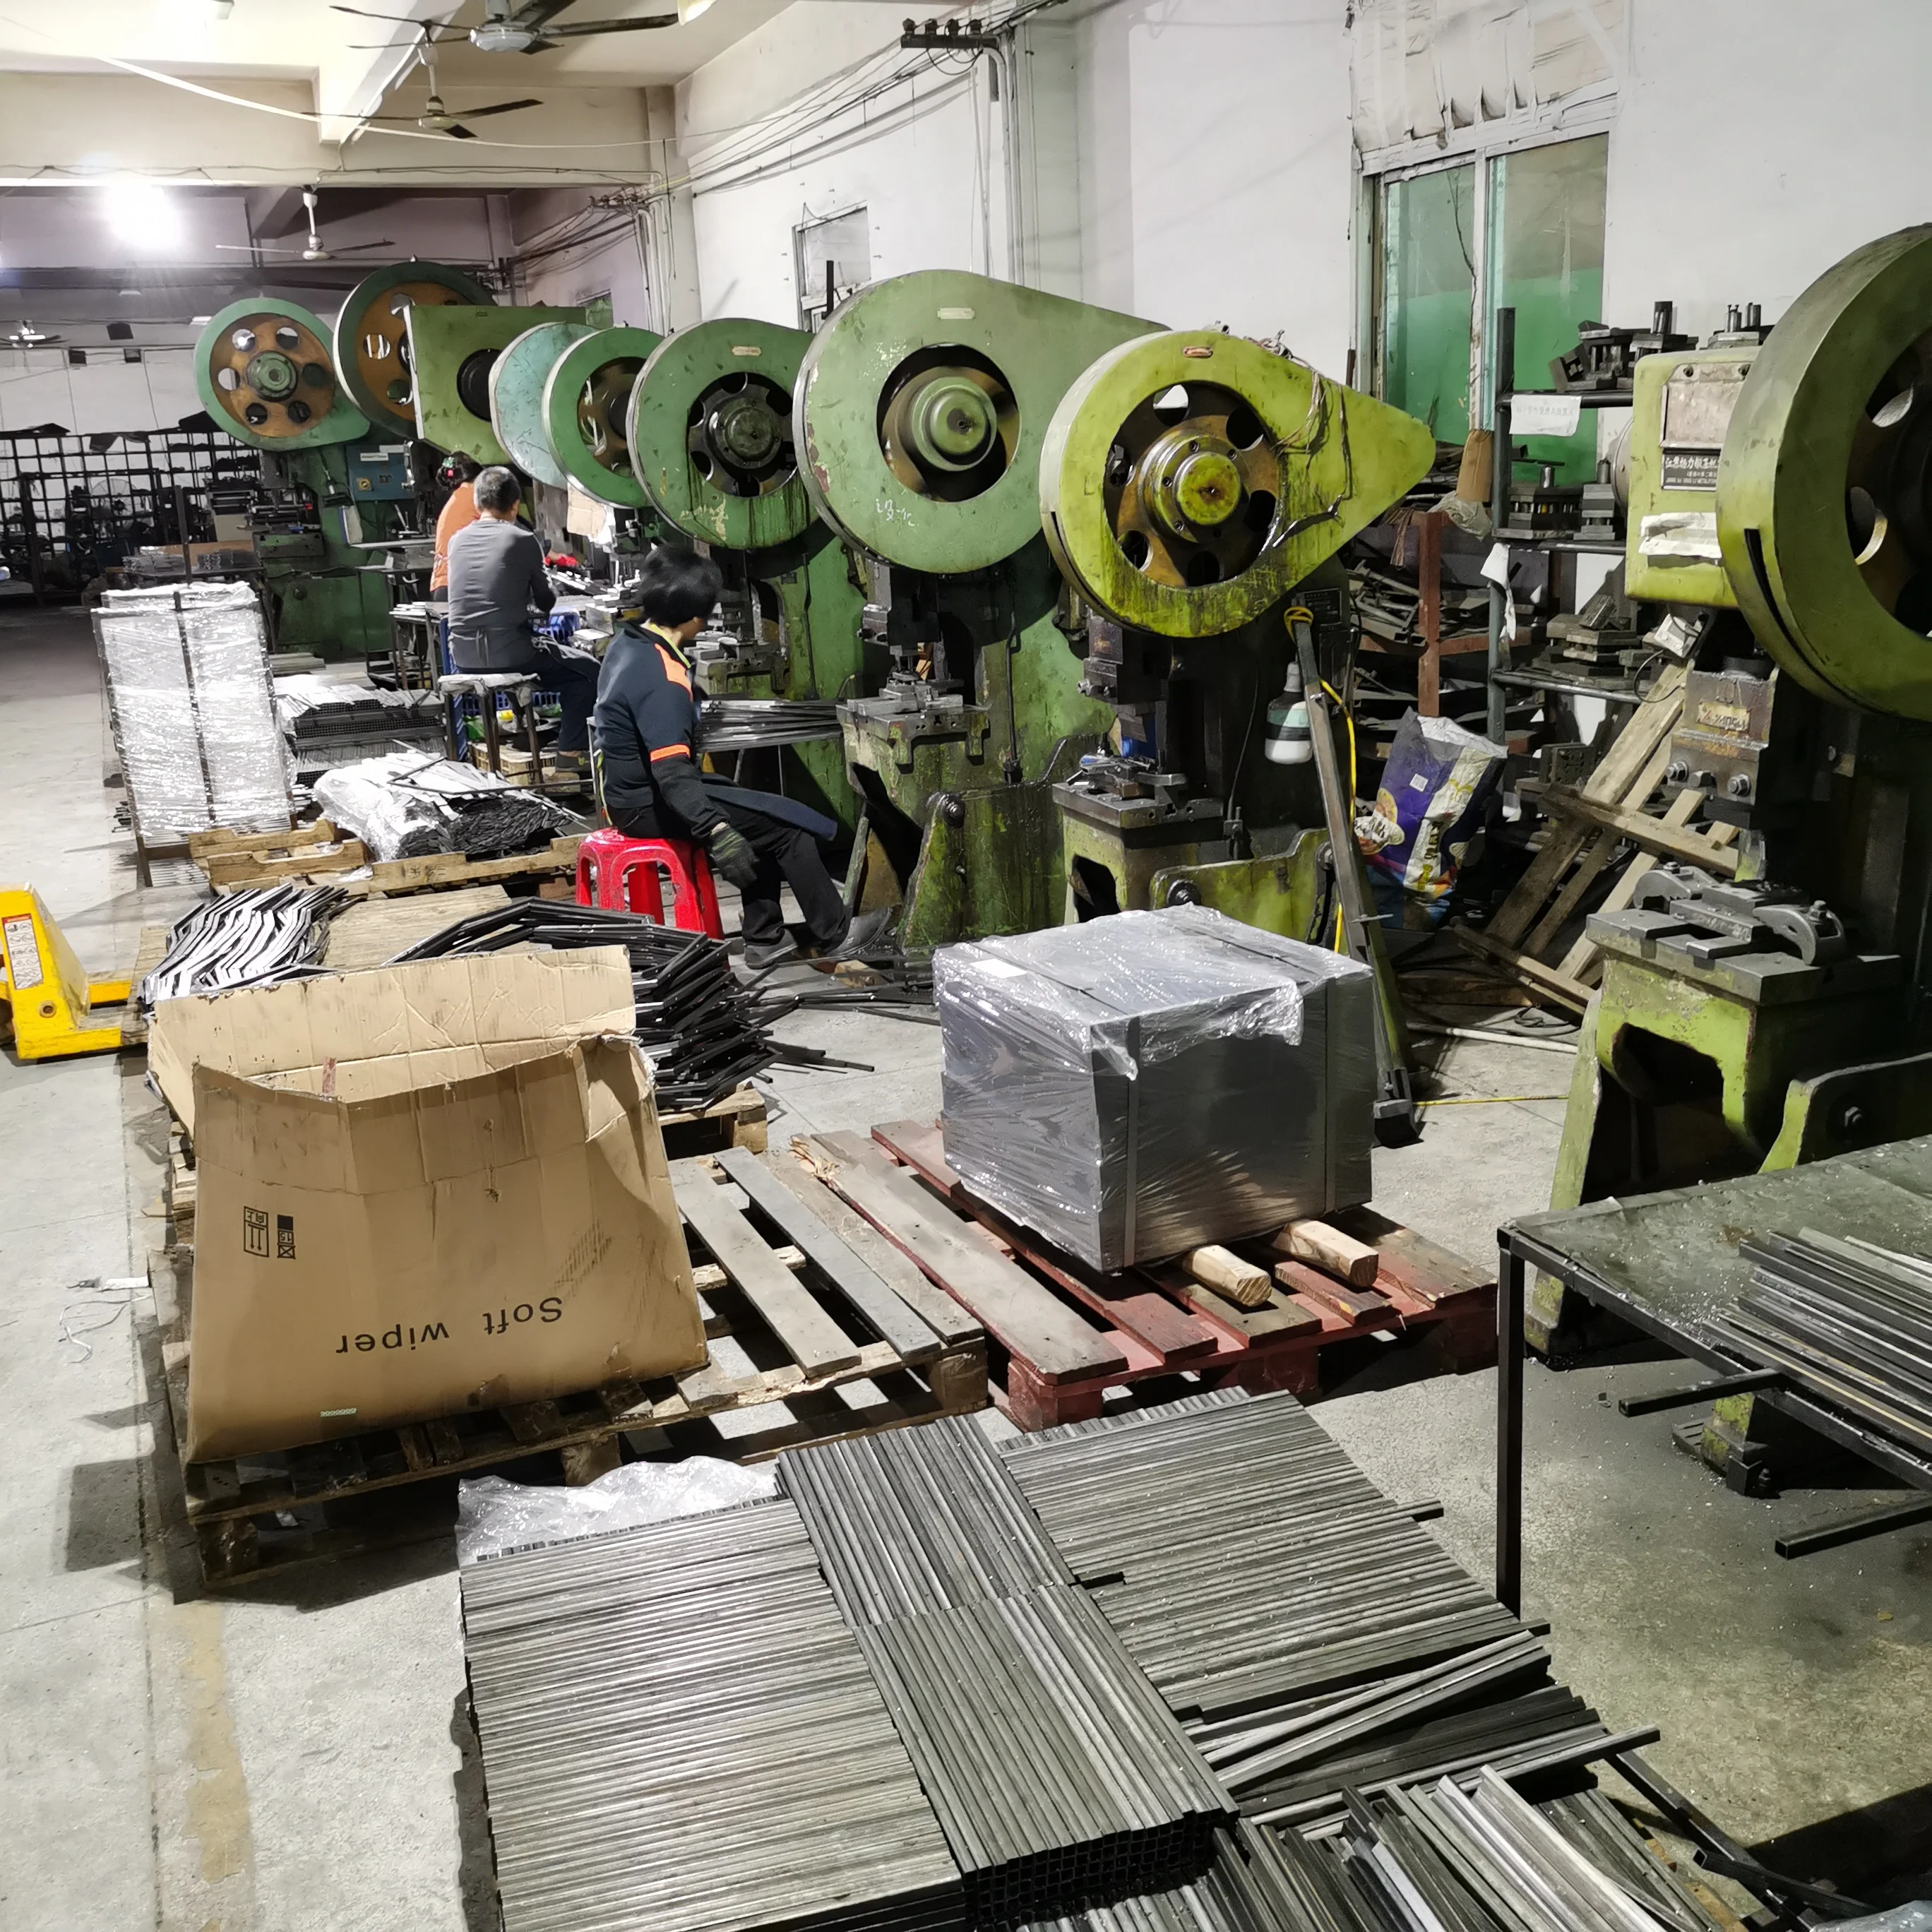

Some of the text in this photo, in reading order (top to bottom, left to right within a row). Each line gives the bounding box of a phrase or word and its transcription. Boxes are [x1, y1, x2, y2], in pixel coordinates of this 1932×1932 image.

[247, 1210, 265, 1224] 向上
[280, 1232, 292, 1242] 15
[336, 1297, 563, 1354] Soft wiper
